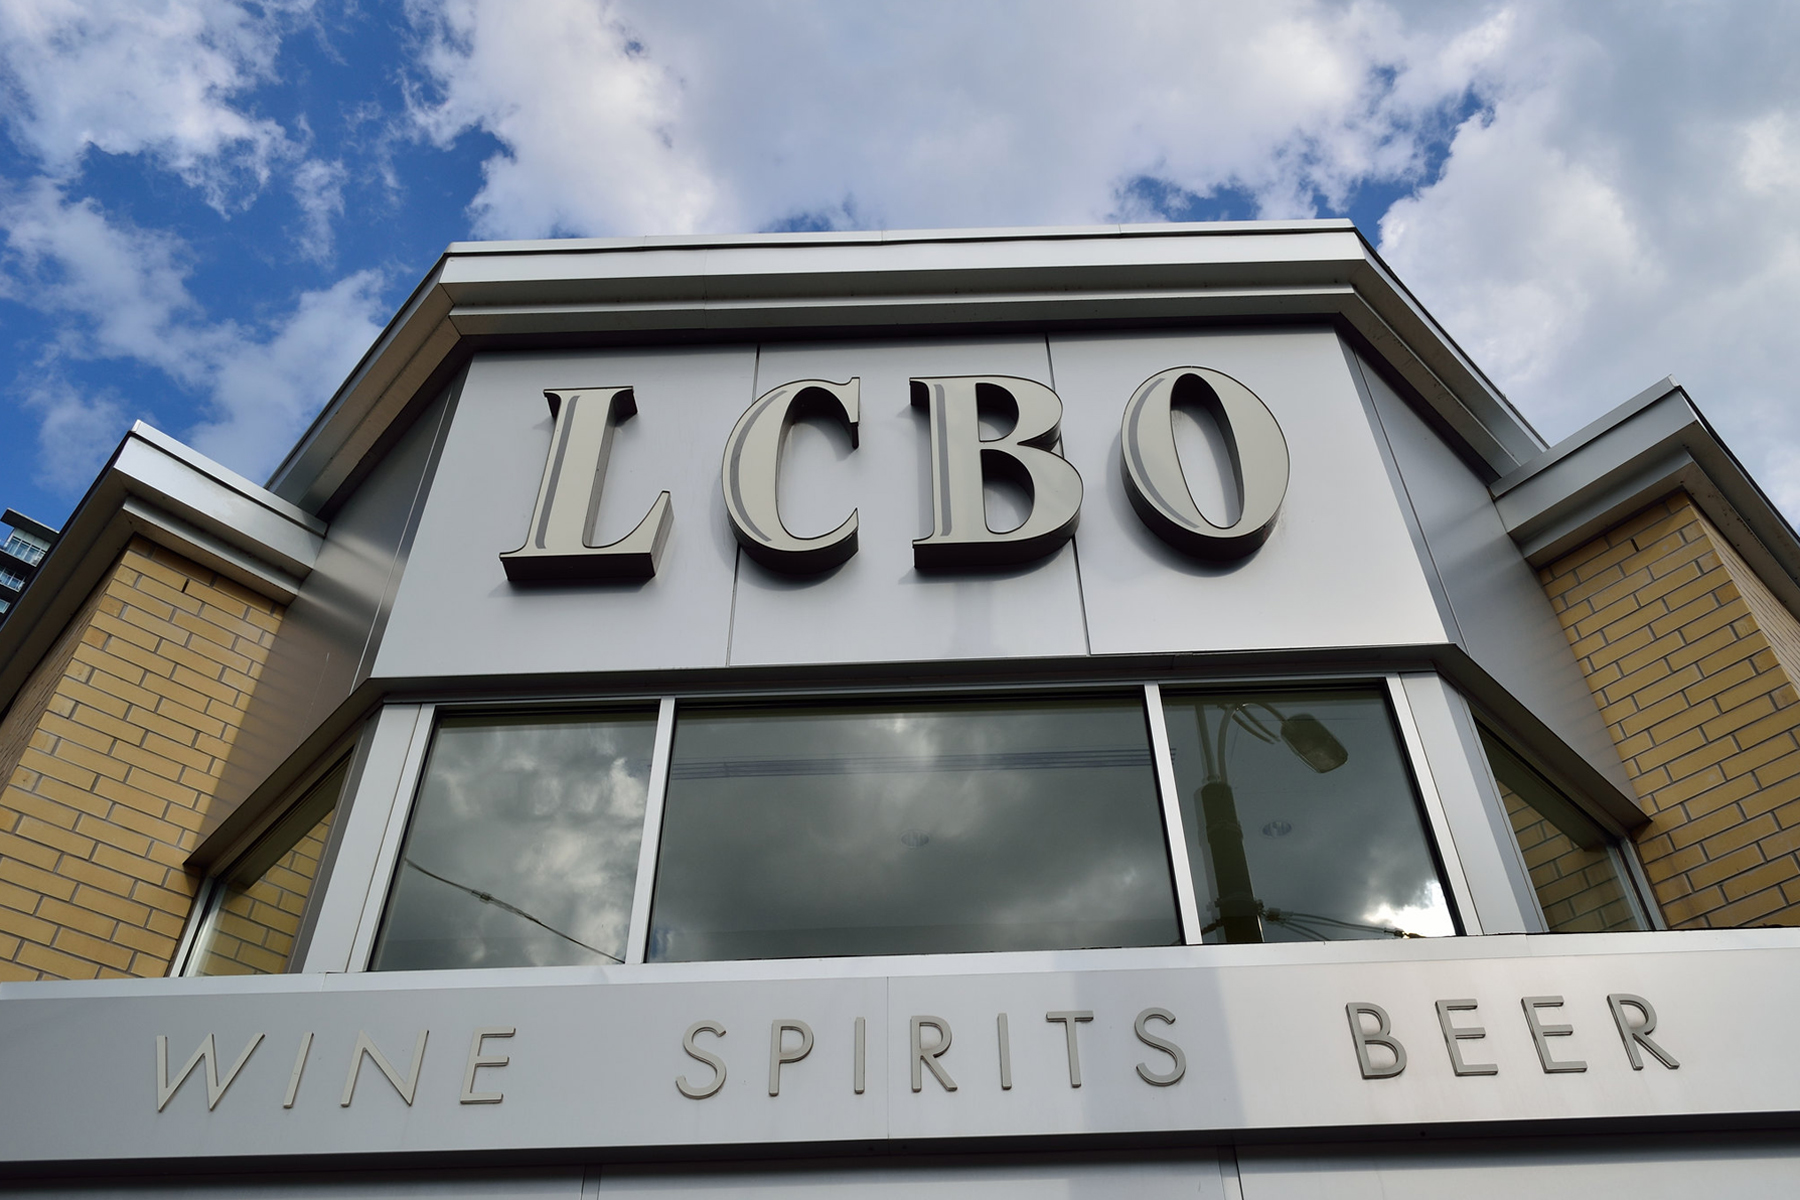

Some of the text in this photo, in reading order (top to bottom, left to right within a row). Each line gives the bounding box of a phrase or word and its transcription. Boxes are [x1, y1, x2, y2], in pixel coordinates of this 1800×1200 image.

[499, 366, 1291, 582] LCBO
[155, 993, 1681, 1113] WINE SPIRITS BEER
